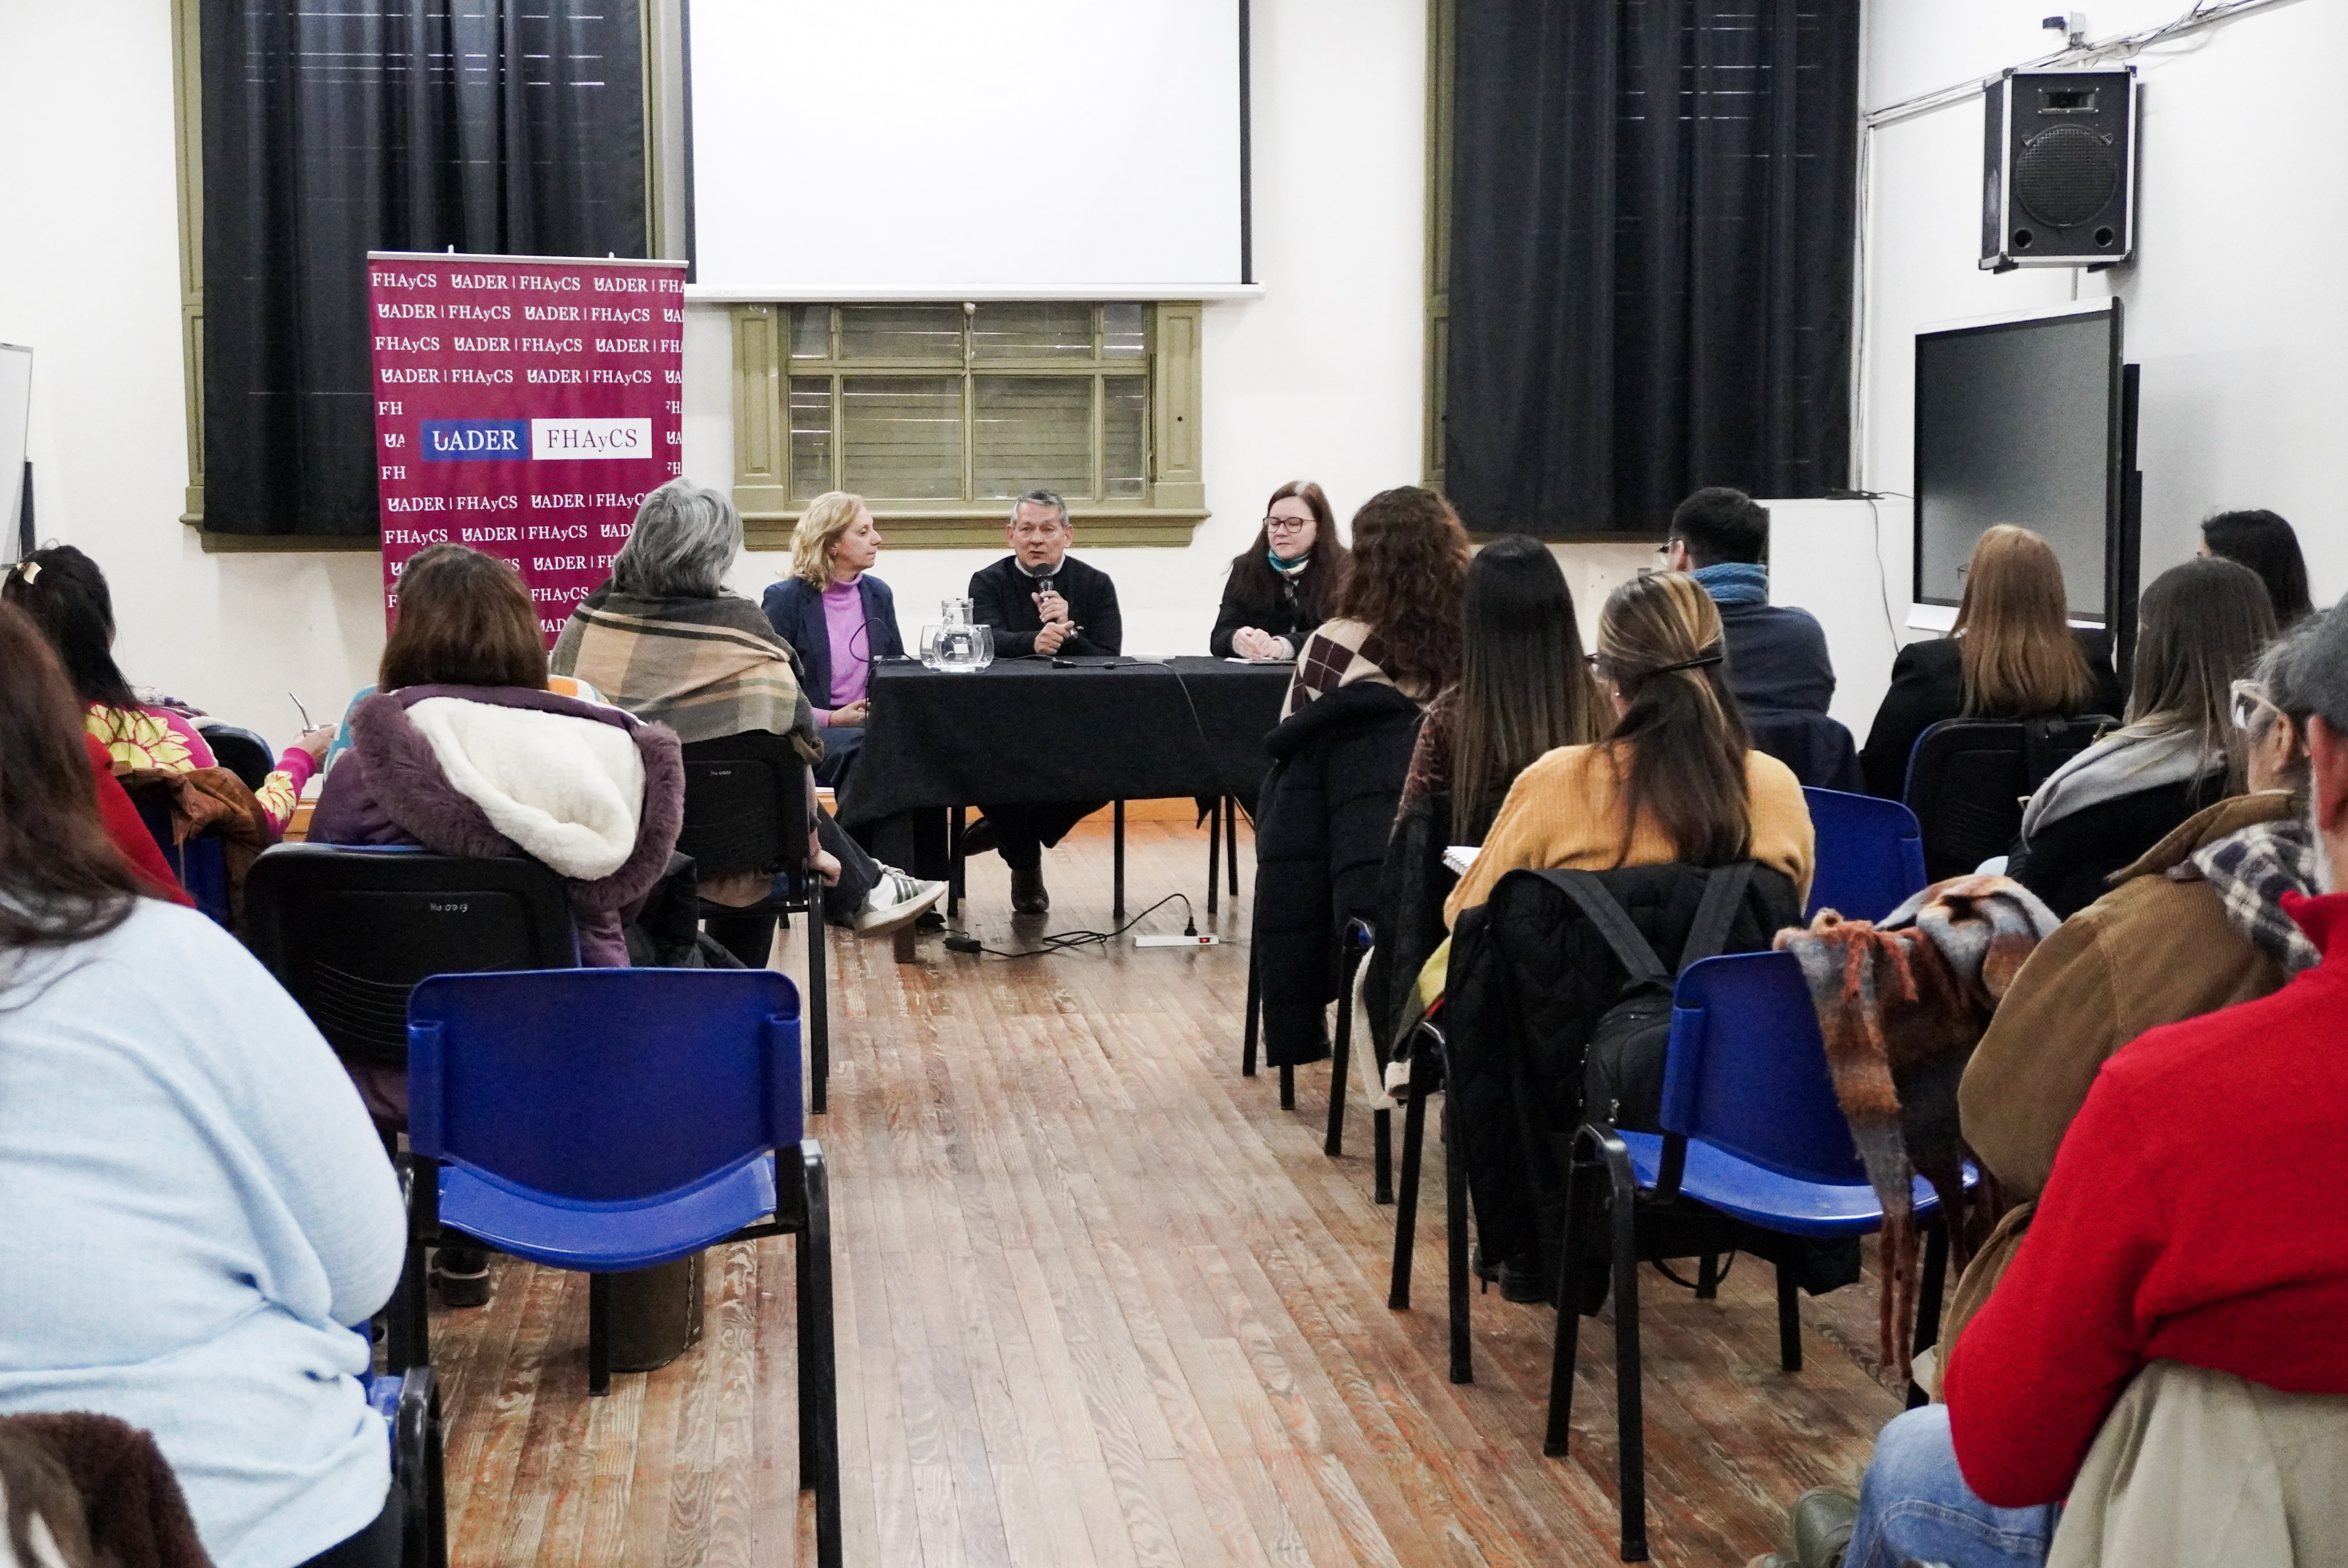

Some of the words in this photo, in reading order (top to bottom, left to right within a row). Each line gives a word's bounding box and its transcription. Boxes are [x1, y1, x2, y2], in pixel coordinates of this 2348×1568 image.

[372, 273, 437, 289] FHAyCS
[452, 274, 508, 289] UADER
[520, 276, 580, 293] FHAyCS
[594, 278, 648, 292] UADER
[377, 304, 437, 318] UADER
[449, 306, 510, 321] FHAyCS
[524, 306, 580, 321] UADER
[591, 307, 649, 324] FHAyCS
[376, 337, 439, 353] FHAyCS
[454, 337, 510, 351] UADER
[522, 338, 582, 354] FHAyCS
[596, 339, 649, 352] UADER
[381, 369, 439, 382] UADER
[452, 370, 513, 385] FHAyCS
[527, 370, 582, 383] UADER
[593, 370, 651, 385] FHAyCS
[432, 430, 518, 450] UADER
[547, 429, 637, 452] FHAyCS
[387, 497, 445, 511] UADER
[457, 496, 517, 511] FHAyCS
[531, 495, 585, 508] UADER
[596, 493, 644, 508] FHAyC
[385, 529, 447, 545] FHAyCS
[462, 527, 517, 541] UADER
[529, 525, 587, 541] FHAyCS
[600, 524, 632, 538] UAD
[533, 556, 586, 570] UADER
[531, 587, 588, 604] FHAyCS
